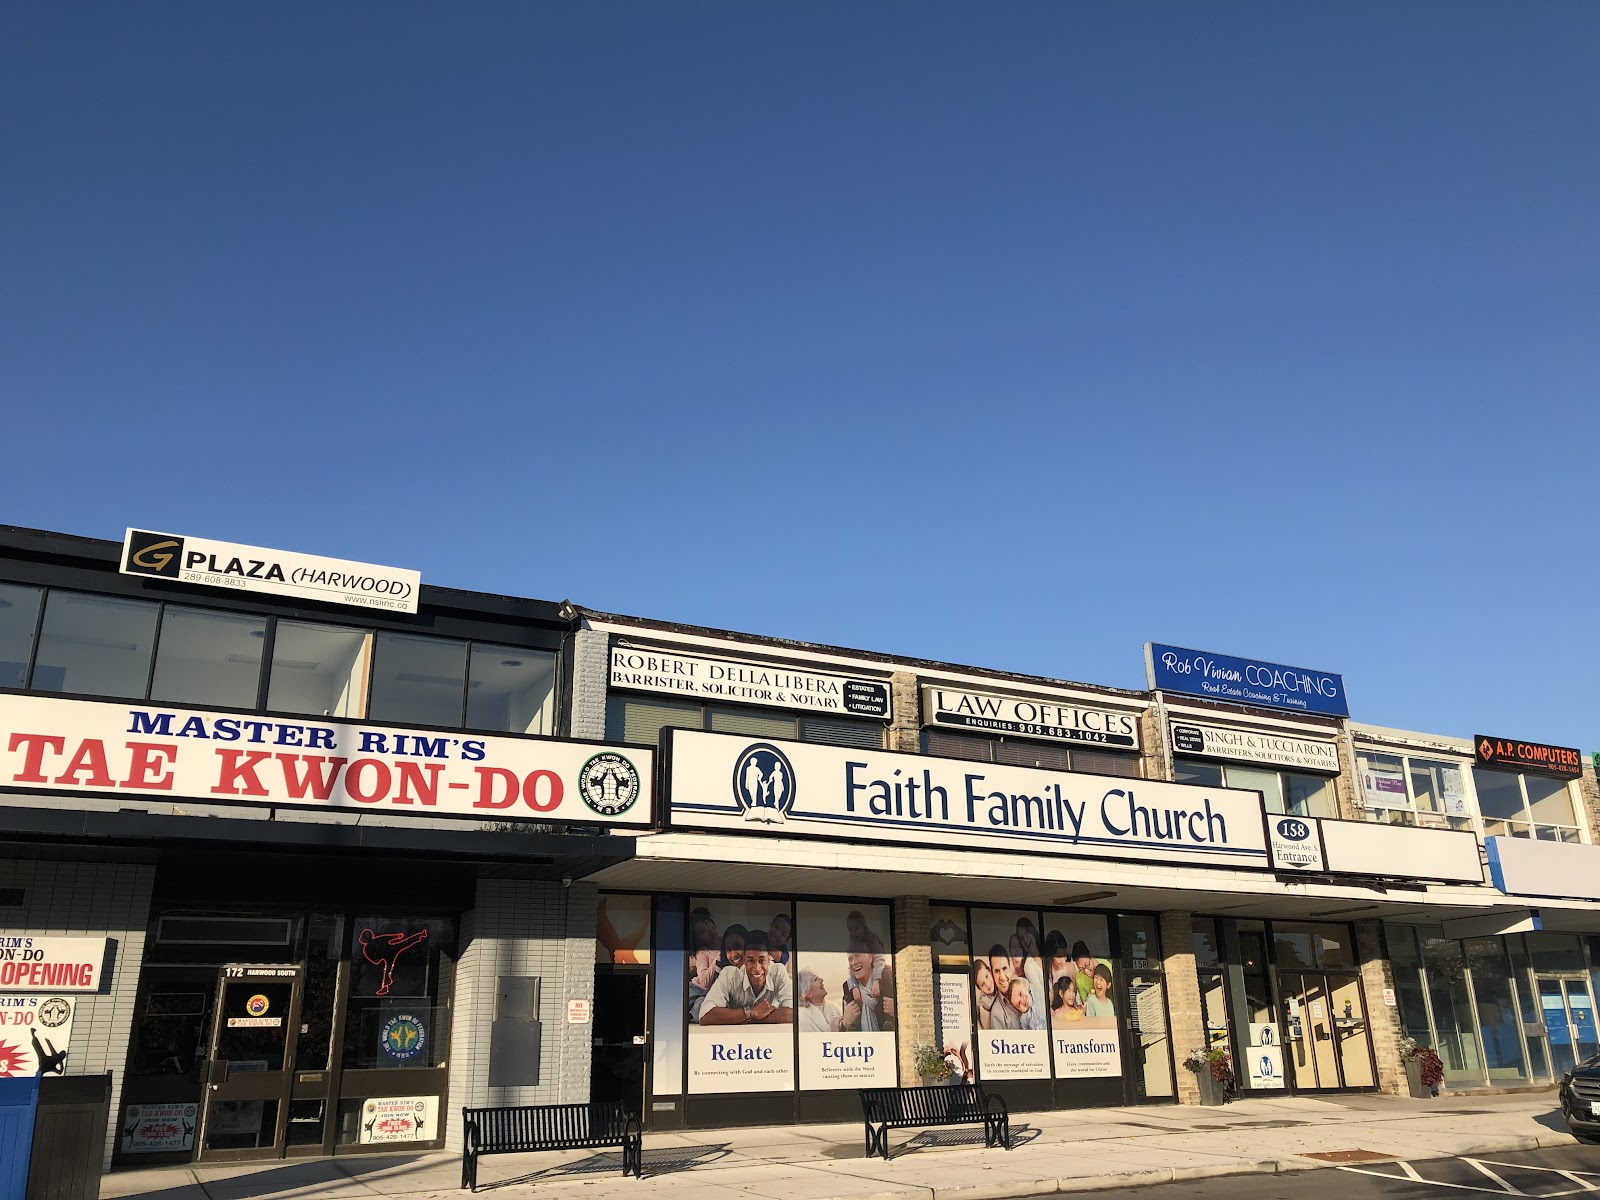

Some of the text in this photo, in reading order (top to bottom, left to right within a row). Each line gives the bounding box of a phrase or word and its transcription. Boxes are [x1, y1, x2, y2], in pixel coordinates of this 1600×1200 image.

[133, 541, 411, 599] G PLAZA (HARWOOD)
[185, 573, 245, 587] 289-608-8833
[345, 595, 407, 609] www.nsiinc.ca
[614, 654, 698, 676] ROBERT
[1162, 652, 1336, 697] Rob Vivian COACHING
[613, 672, 839, 708] BARRISTER, SOLICITOR & NOTARY
[1202, 682, 1306, 709] Real Estate Coaching & Training
[852, 704, 881, 712] LITIGATION
[937, 692, 1132, 734] LAW OFFICES
[127, 711, 485, 761] MASTER RIM'S
[966, 718, 1107, 742] ENQUIRIES: 905.683.1042
[1205, 731, 1334, 757] SINGH & TUCCIARONE
[1497, 741, 1514, 757] A.P.
[1518, 744, 1578, 765] COMPUTERS
[589, 758, 599, 766] TAE
[1255, 751, 1294, 763] SOLICITORS
[1304, 758, 1336, 767] NOTARIES
[8, 733, 564, 812] TAE KWON-DO
[581, 767, 589, 789] WORLD
[583, 792, 591, 804] THE
[626, 770, 637, 806] FEDERATION
[846, 761, 1227, 844] Faith Family Church
[1283, 823, 1305, 837] 158
[1273, 842, 1299, 850] Harwood
[1277, 850, 1317, 862] Entrance
[0, 962, 93, 986] OPENING
[226, 968, 243, 977] 172
[712, 1044, 772, 1060] Relate
[822, 1042, 874, 1063] Equip
[991, 1039, 1035, 1054] Share
[1057, 1039, 1115, 1053] Transform
